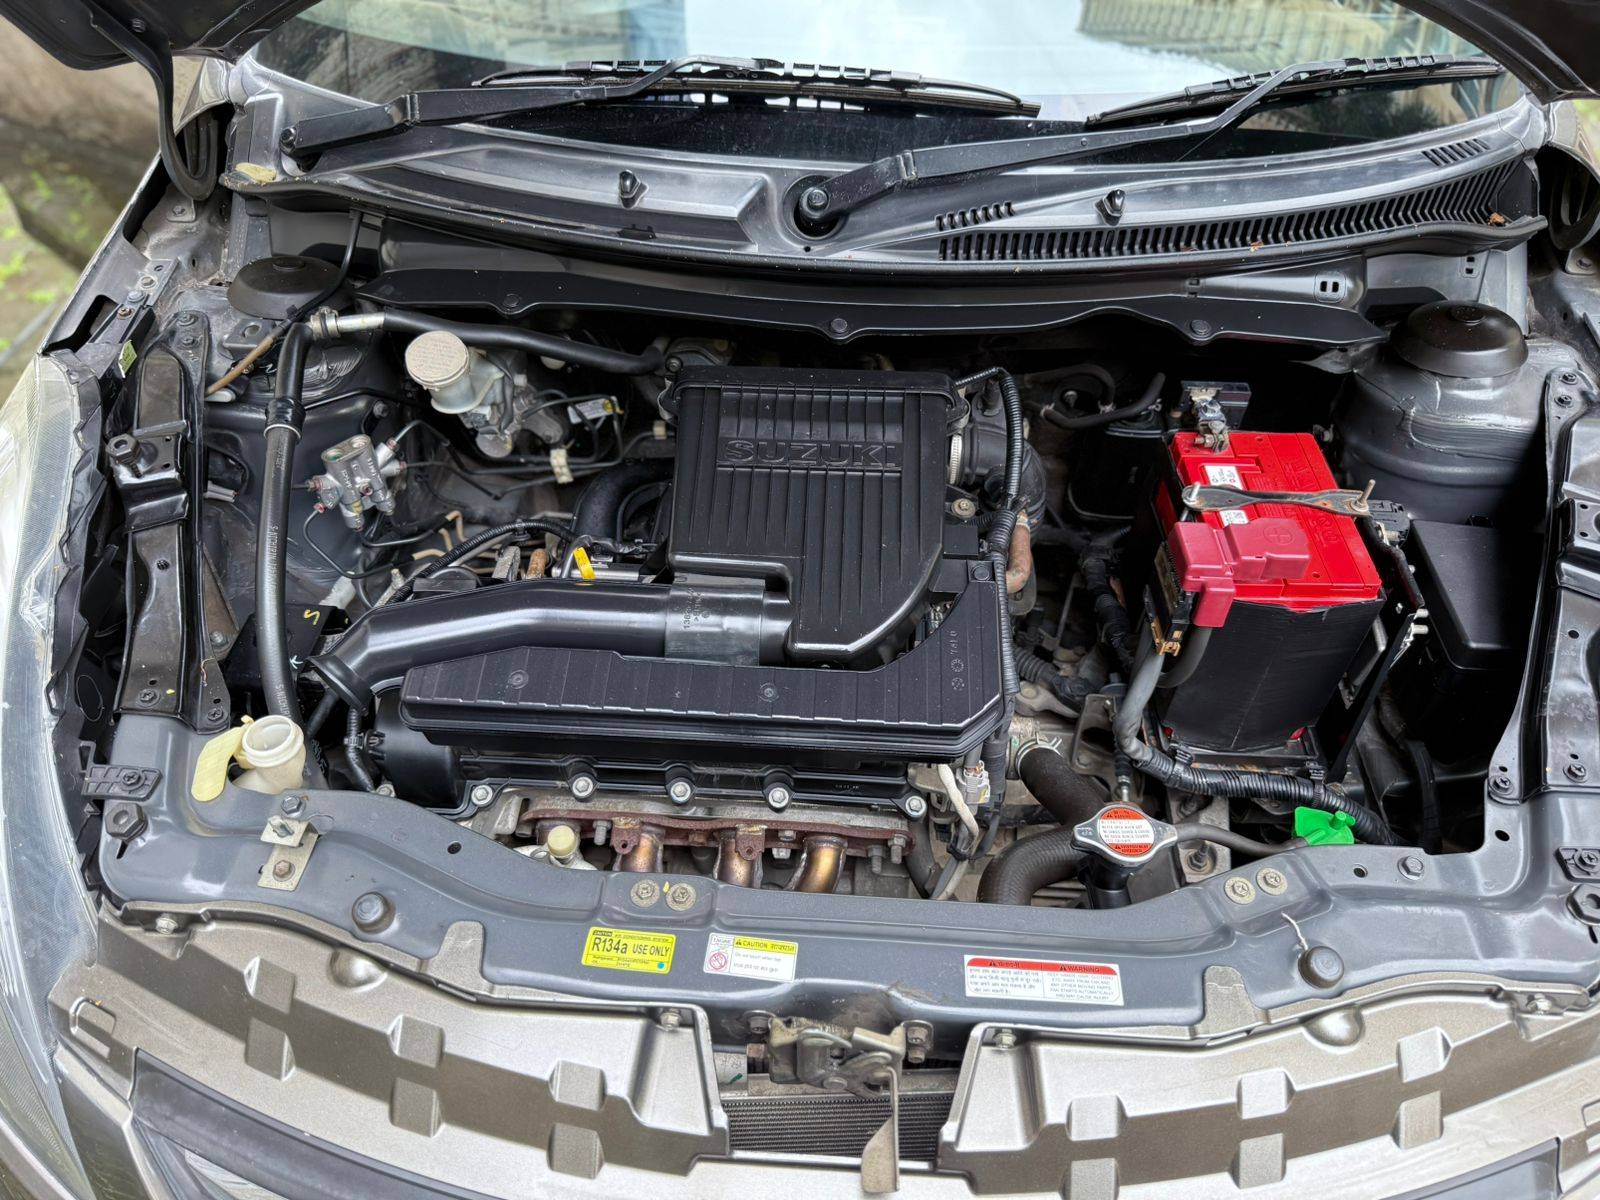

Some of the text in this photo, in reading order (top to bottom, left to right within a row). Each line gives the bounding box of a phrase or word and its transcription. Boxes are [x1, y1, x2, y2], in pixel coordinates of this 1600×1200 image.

[723, 439, 896, 467] SUZUKI
[591, 937, 671, 956] R134a USE ONLY
[742, 939, 768, 949] CAUTION
[1068, 965, 1100, 973] WARNING
